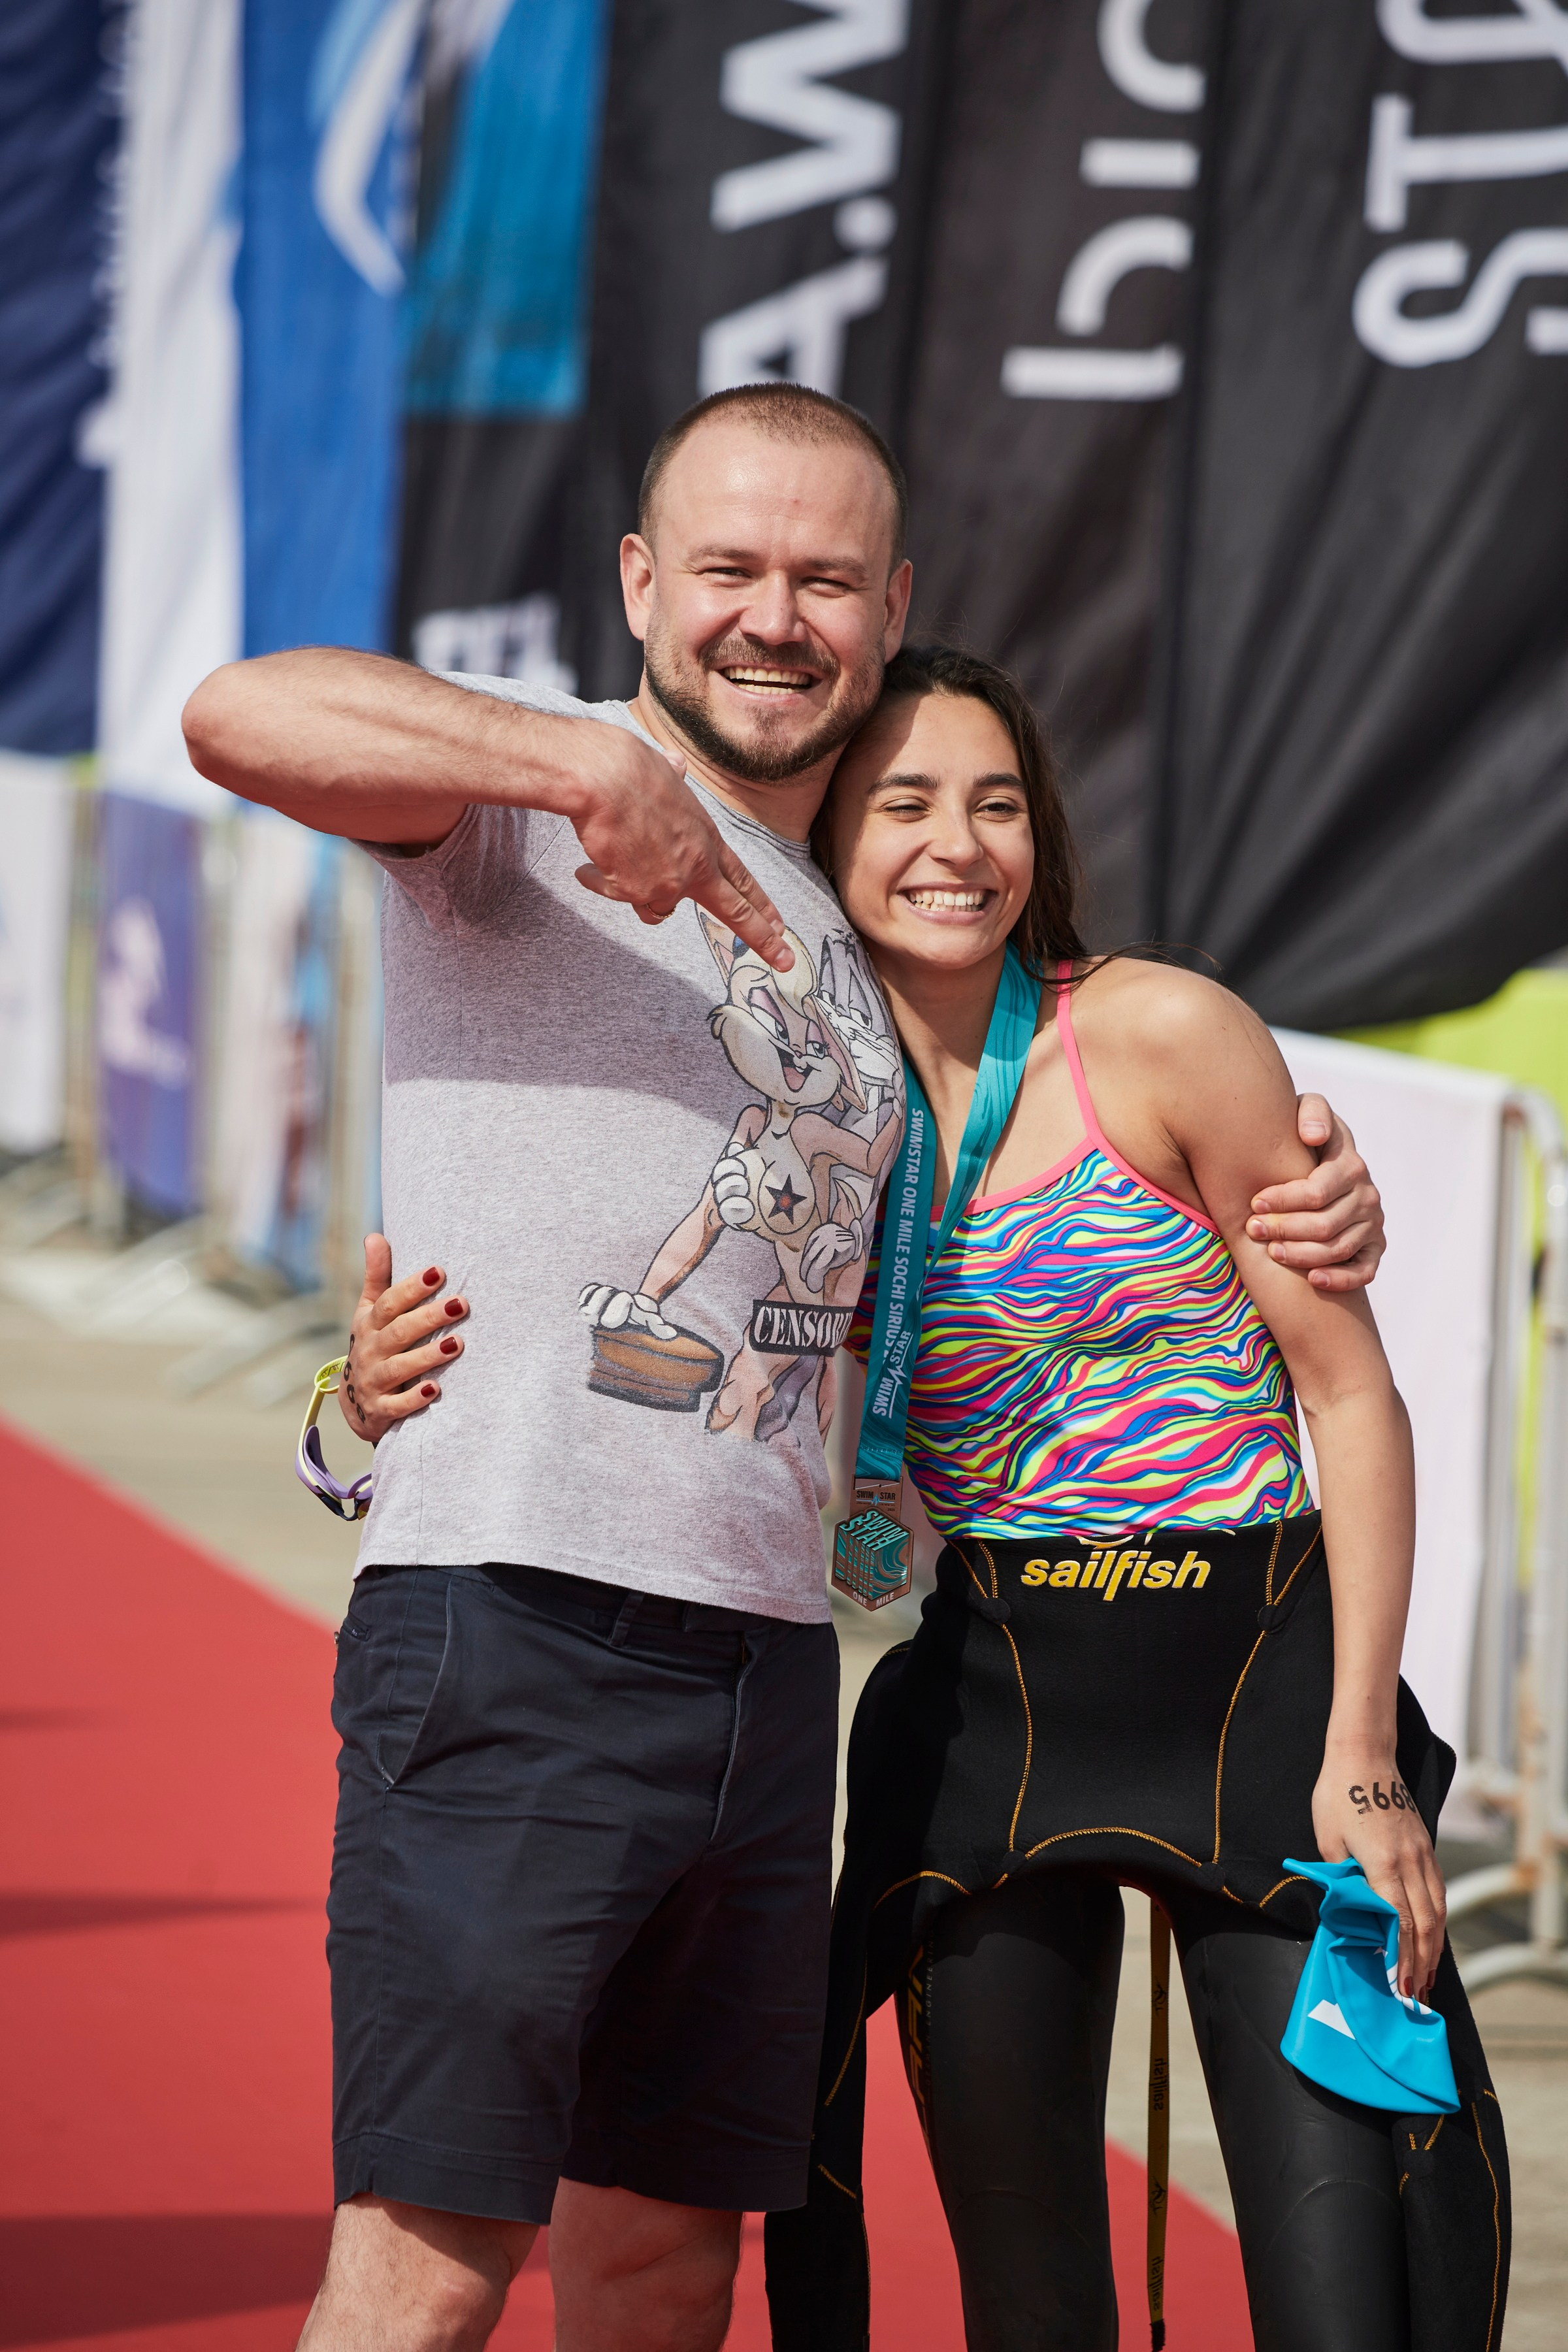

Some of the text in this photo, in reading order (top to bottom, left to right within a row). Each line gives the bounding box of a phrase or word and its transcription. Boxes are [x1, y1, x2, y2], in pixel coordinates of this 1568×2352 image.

[904, 1108, 924, 1186] SWIMSTAR
[900, 1186, 917, 1217] ONE
[896, 1219, 913, 1254] MILE
[890, 1256, 909, 1300] SOCHI
[885, 1301, 904, 1347] SIRIUS
[889, 1330, 911, 1365] STAR
[872, 1377, 894, 1417] SWIM
[857, 1490, 896, 1501] SWIM STAR
[839, 1515, 890, 1551] STAR
[862, 1511, 909, 1540] SWIM
[1021, 1549, 1211, 1601] sailfish
[853, 1591, 894, 1608] ONE MILE
